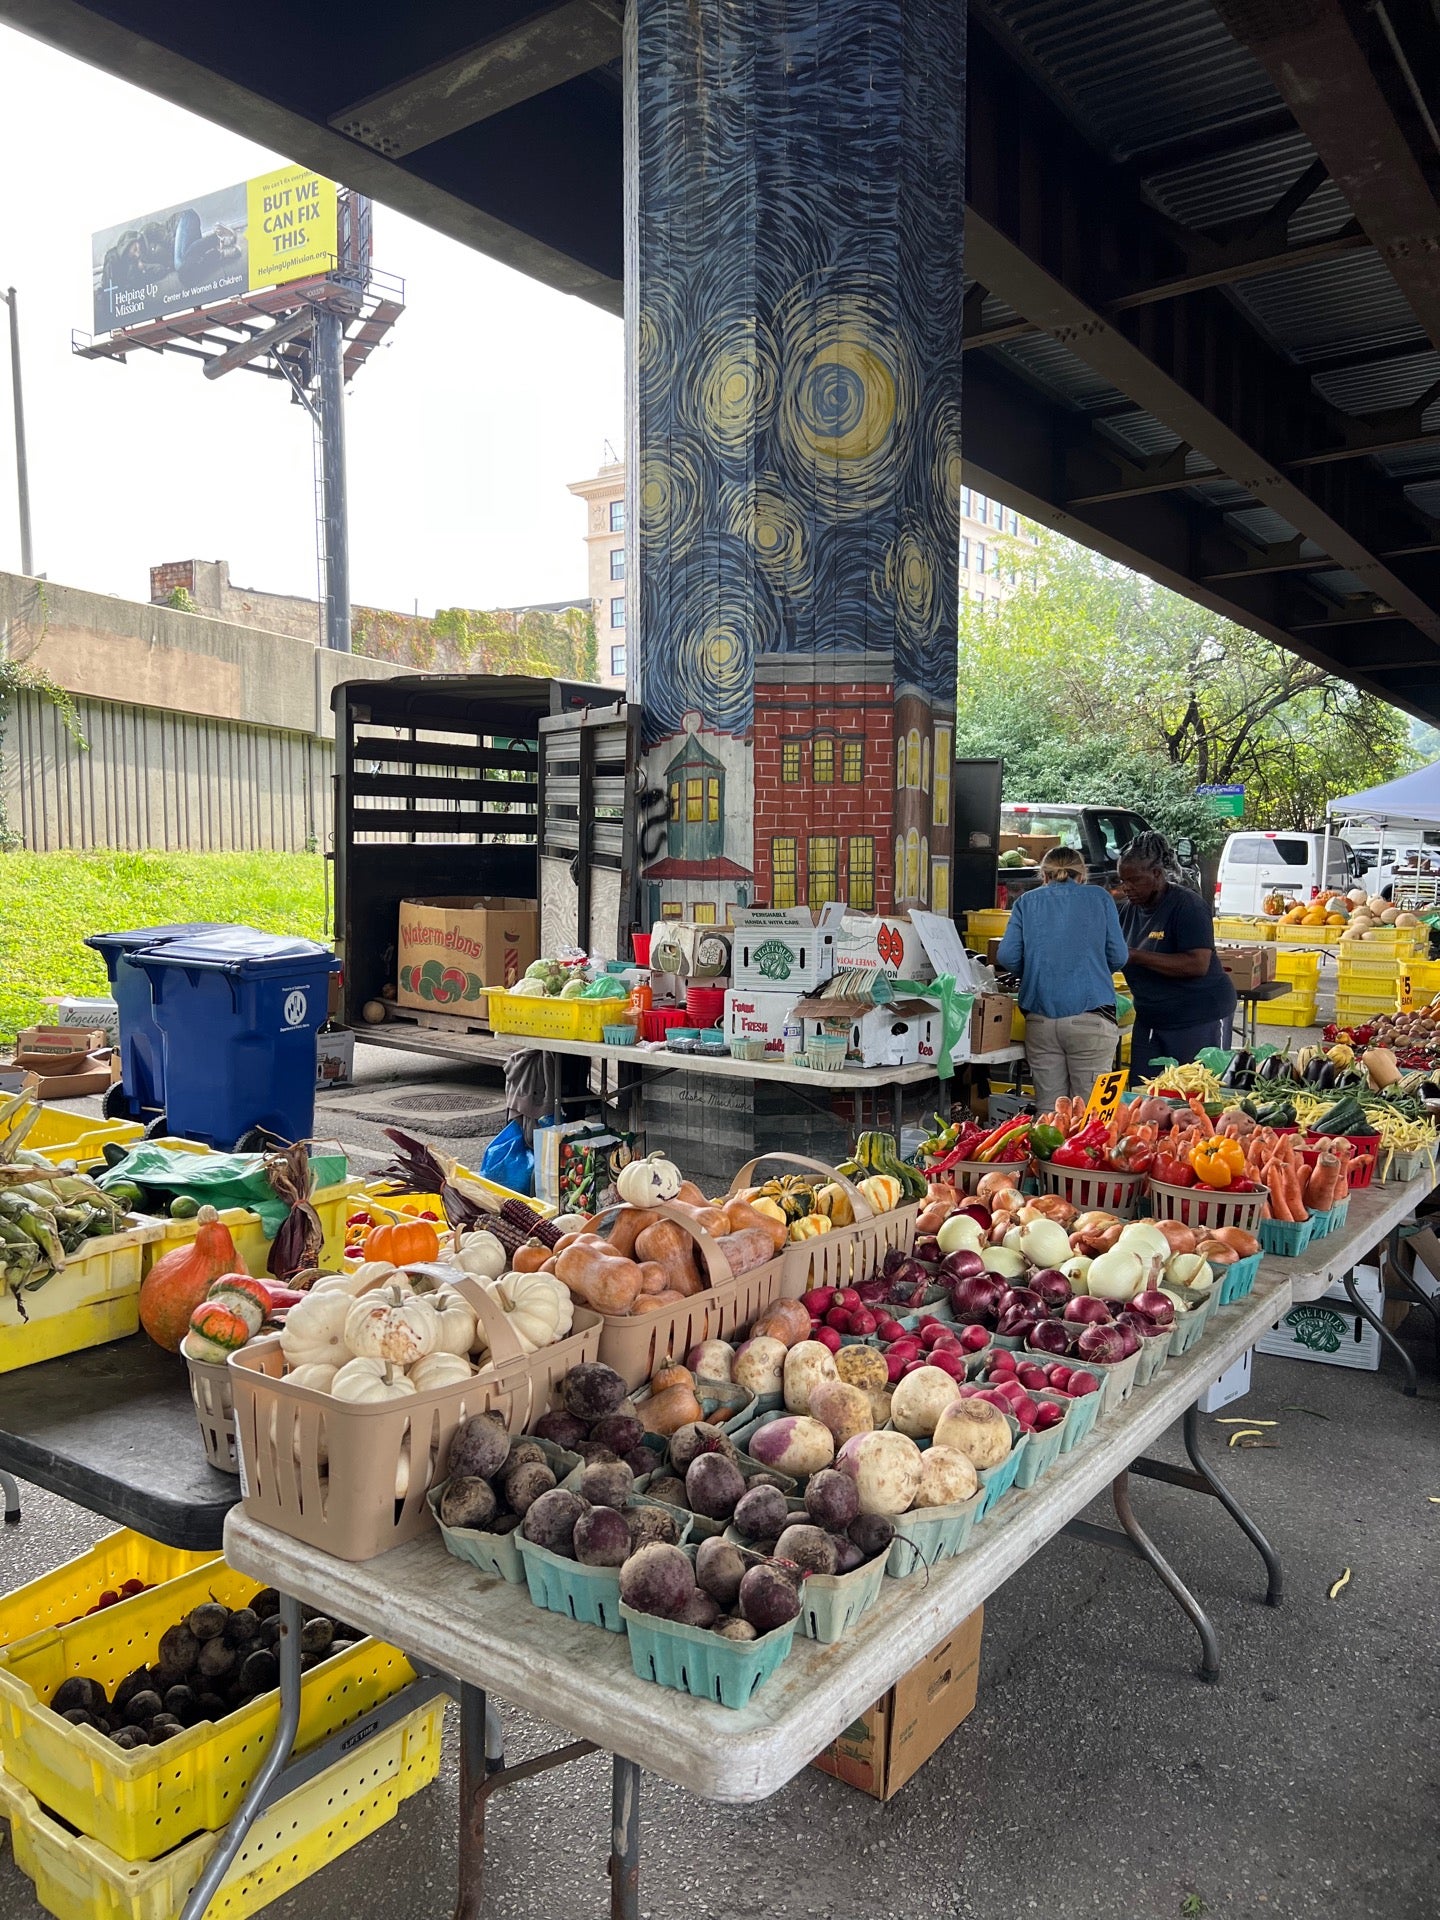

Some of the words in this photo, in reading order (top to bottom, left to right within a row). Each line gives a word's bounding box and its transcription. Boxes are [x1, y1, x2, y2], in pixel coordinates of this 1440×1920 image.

[263, 189, 292, 214] BUT
[295, 180, 320, 202] WE
[263, 210, 294, 234] CAN
[298, 201, 320, 224] FIX
[272, 228, 310, 252] THIS.
[257, 250, 328, 276] HelpingUpMission.org
[115, 288, 146, 305] Helping
[146, 283, 158, 298] Up
[163, 293, 182, 304] Center
[181, 288, 191, 298] for
[190, 284, 213, 296] Women
[212, 281, 218, 290] &
[218, 274, 243, 288] Children
[115, 300, 145, 317] Mission
[400, 920, 484, 959] Watermelons
[754, 945, 794, 962] VEGETABLES
[836, 955, 854, 964] POTA
[855, 957, 877, 968] SWEET
[64, 1011, 118, 1026] Vegetables
[741, 1017, 769, 1033] FRESH
[1100, 1073, 1123, 1106] $5
[1288, 1307, 1346, 1332] VEGETABLES
